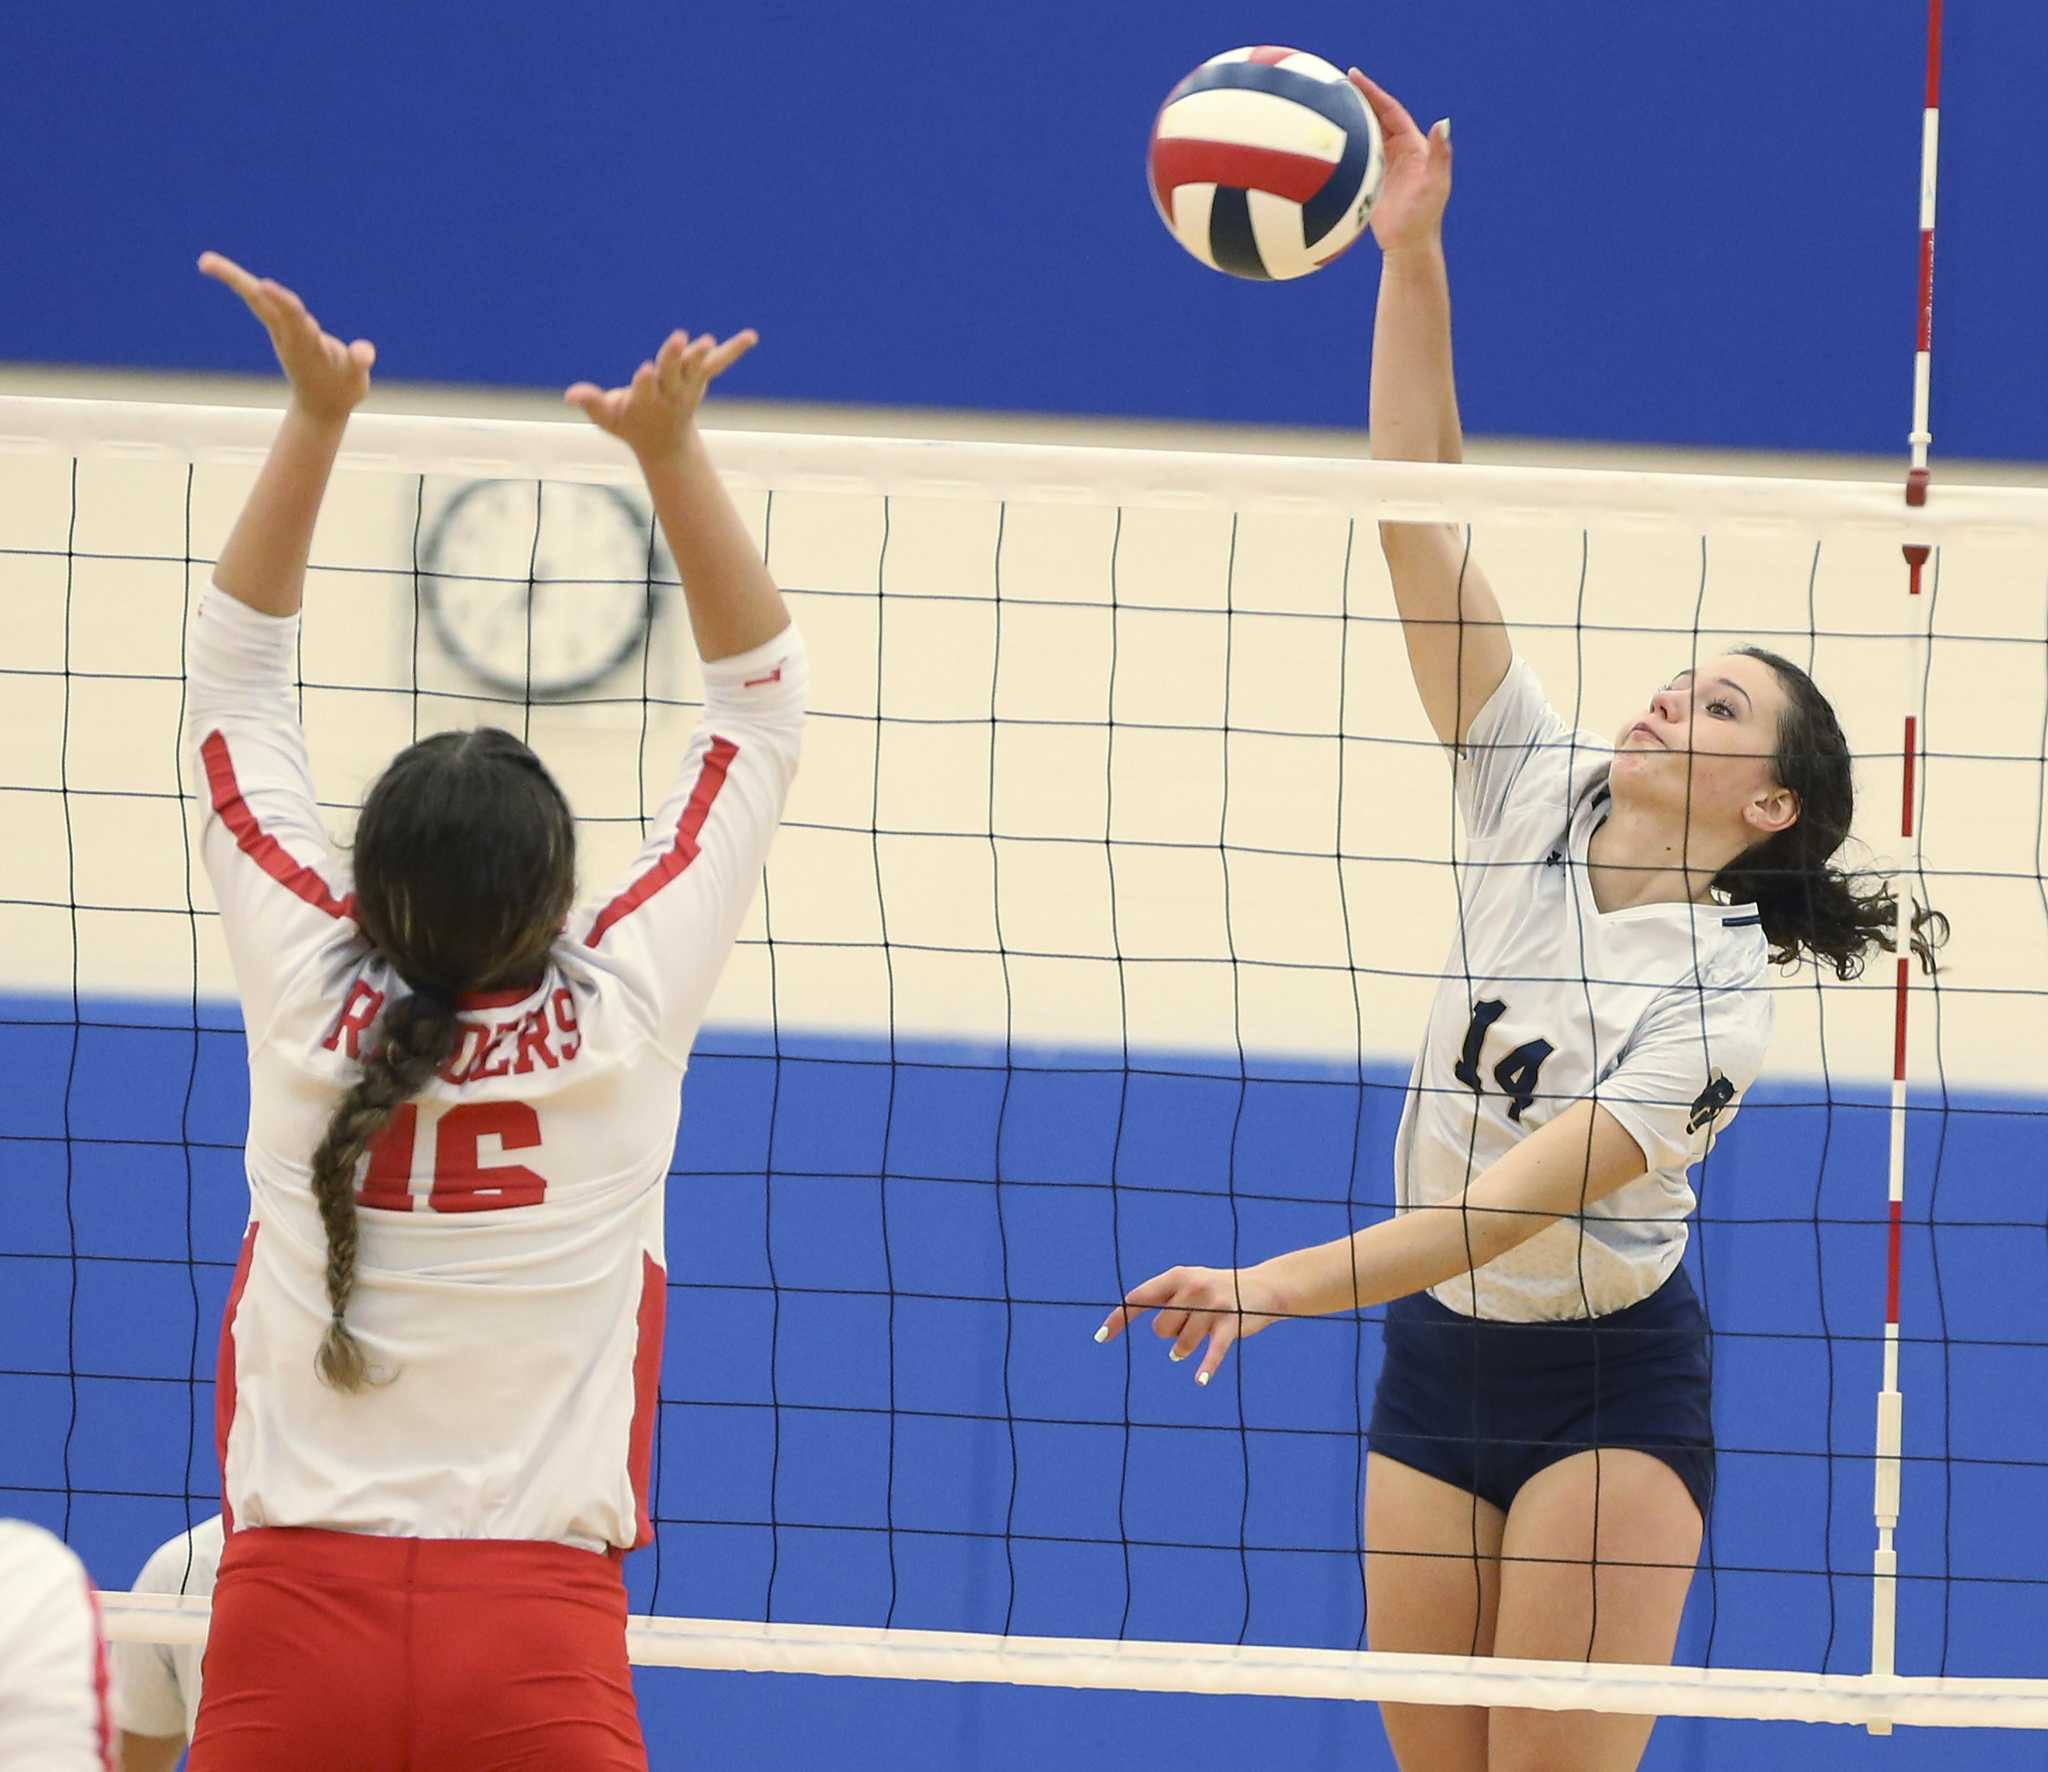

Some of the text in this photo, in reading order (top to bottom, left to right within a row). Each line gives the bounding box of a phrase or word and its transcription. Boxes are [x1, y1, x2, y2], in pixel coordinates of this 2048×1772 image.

[321, 979, 582, 1086] RDERS
[1455, 1000, 1555, 1122] 14
[354, 1100, 547, 1213] 16
